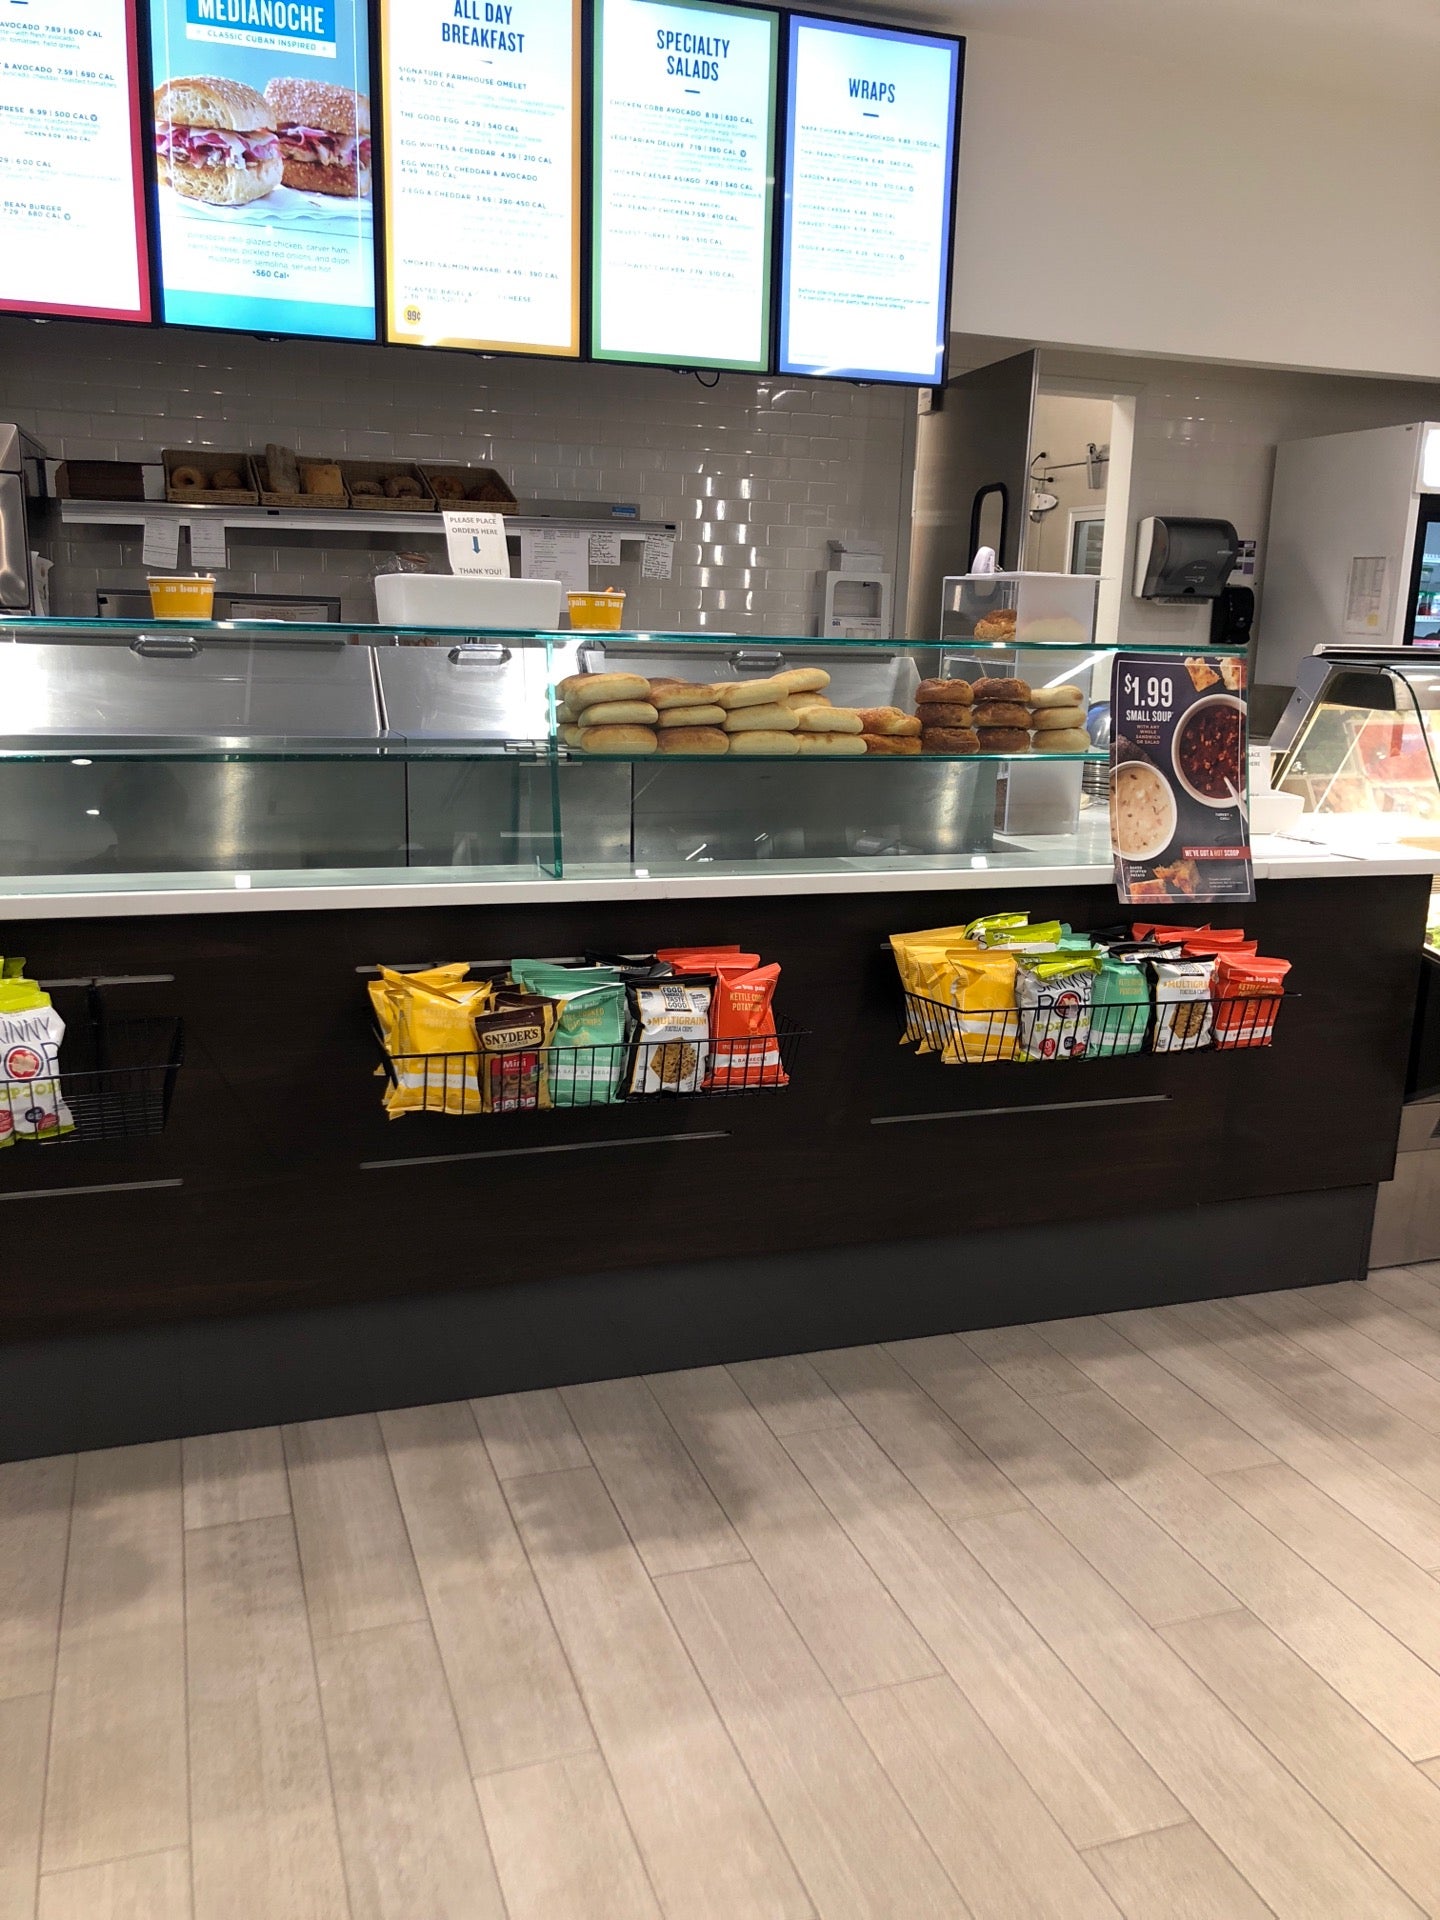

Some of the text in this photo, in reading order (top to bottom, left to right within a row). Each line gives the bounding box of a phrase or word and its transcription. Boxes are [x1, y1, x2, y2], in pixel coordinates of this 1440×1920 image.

[199, 0, 325, 34] MEDIANOCHE
[454, 0, 512, 25] ALL DAY
[0, 22, 39, 31] AVOCADO
[69, 28, 84, 36] 600
[87, 30, 103, 38] CAL
[442, 22, 525, 53] BREAKFAST
[207, 29, 316, 51] CLASSIC CUBAN INSPIRED
[656, 29, 730, 59] SPECIALTY
[12, 64, 52, 73] AVOCADO
[99, 73, 115, 81] CAL
[667, 55, 719, 81] SALADS
[399, 66, 527, 90] SIGNATURE FARMHOUSE OMELET
[440, 80, 455, 89] CAL
[848, 78, 896, 103] WRAPS
[73, 112, 89, 120] CAL
[609, 99, 641, 109] CHICKEN
[644, 103, 664, 112] COBB
[666, 107, 700, 117] AVOCADO
[740, 116, 754, 124] CAL
[400, 110, 414, 119] THE
[418, 113, 441, 123] GOOD
[444, 116, 460, 125] EGG
[505, 124, 519, 133] CAL
[400, 139, 417, 147] EGG
[419, 141, 450, 151] WHITES
[459, 146, 496, 156] CHEDDAR
[538, 155, 553, 165] CAL
[609, 134, 736, 156] VEGETARIAN DELUXE CAL
[401, 159, 416, 167] EGG
[454, 165, 491, 176] CHEDDAR
[500, 171, 538, 182] AVOCADO
[674, 175, 700, 184] ASIAGO
[29, 203, 62, 211] BURGER
[434, 190, 471, 200] CHEDDAR
[532, 201, 547, 210] CAL
[659, 207, 689, 216] CHICKEN
[725, 214, 738, 222] CAL
[245, 237, 272, 247] glazed
[709, 238, 723, 246] CAL
[242, 247, 270, 257] pickled
[272, 250, 284, 258] red
[438, 262, 470, 271] SALMON
[472, 265, 502, 274] WASABI
[545, 271, 559, 280] CAL
[722, 271, 736, 279] CAL
[407, 309, 421, 321] 99¢
[1124, 673, 1173, 707] $1.99
[1126, 710, 1172, 722] SMALL SOUP
[730, 992, 750, 1000] KETTLE
[653, 1016, 706, 1025] MULTIGRAIN
[485, 1028, 538, 1045] SNYDER'S
